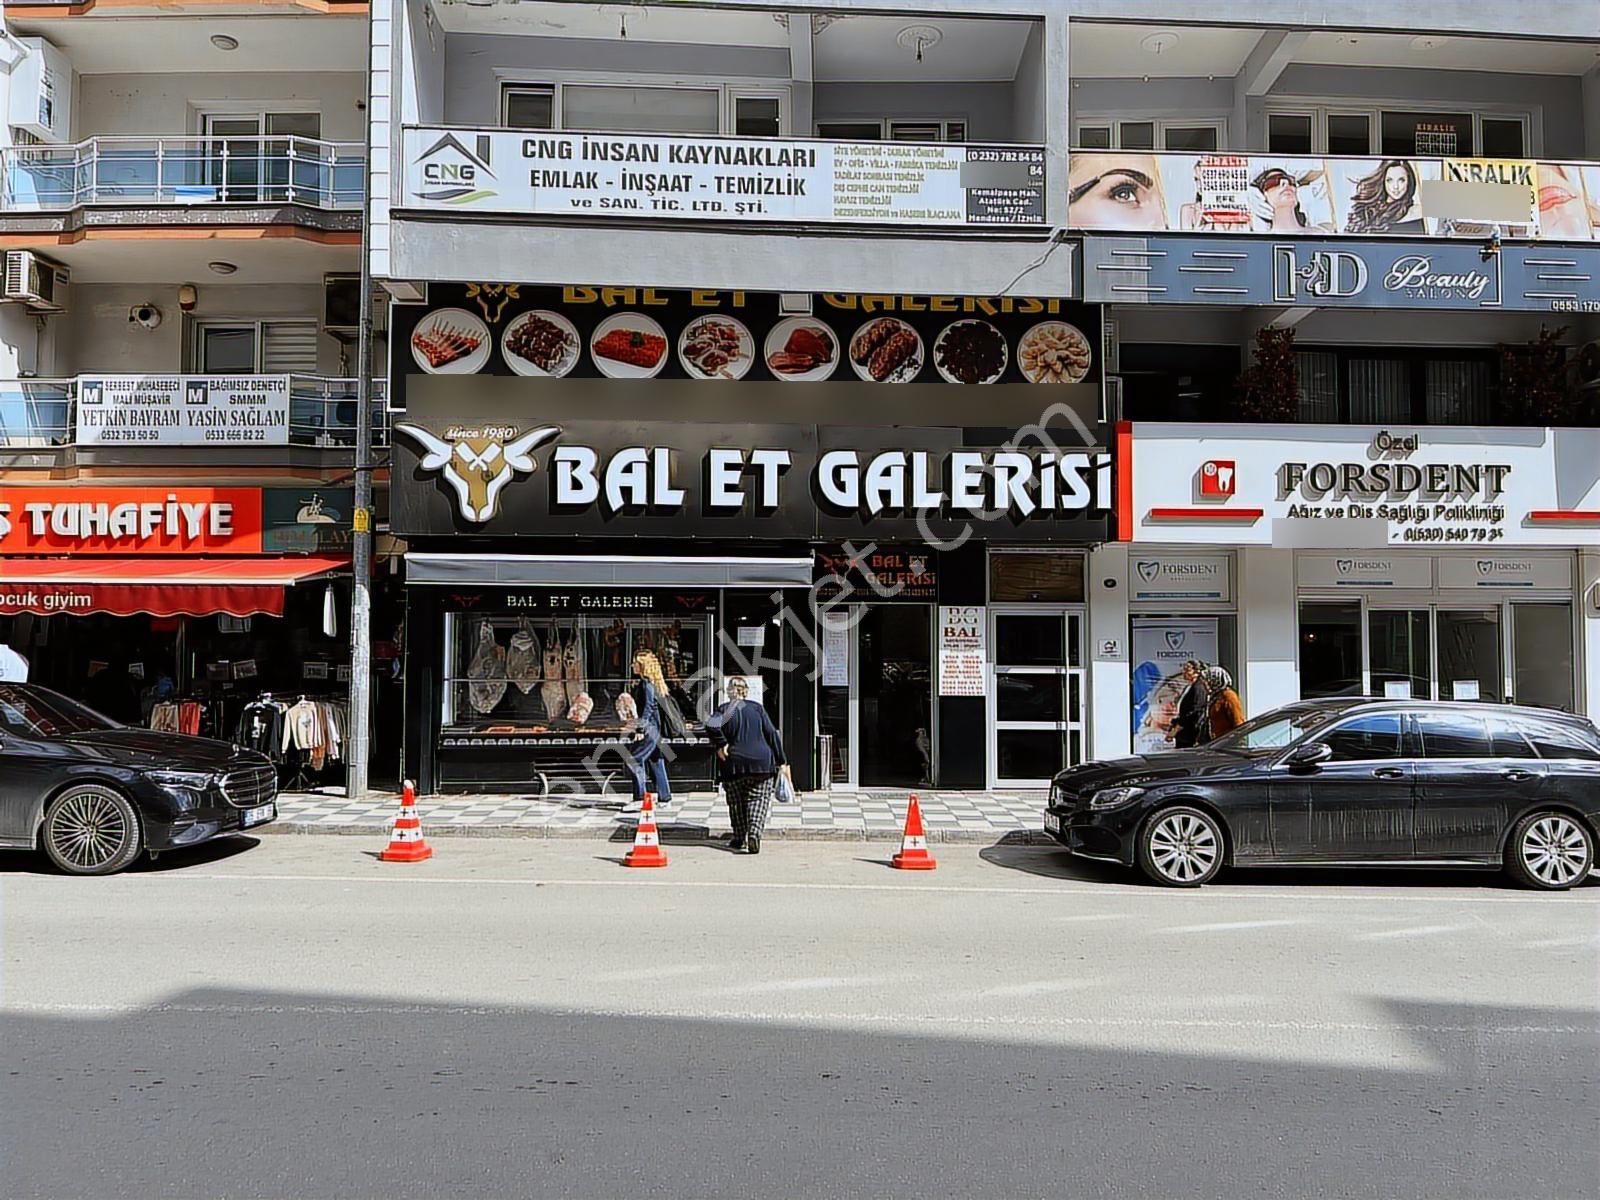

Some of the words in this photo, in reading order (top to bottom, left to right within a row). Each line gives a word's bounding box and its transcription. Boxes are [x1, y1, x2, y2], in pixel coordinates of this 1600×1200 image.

[522, 139, 572, 159] CNG
[582, 136, 659, 162] İNSAN
[669, 144, 816, 168] KAYNAKLARI
[424, 163, 475, 180] CNG
[530, 169, 599, 190] EMLAK
[621, 167, 693, 197] İNŞAAT
[714, 172, 806, 197] TEMİZLİK
[570, 199, 592, 208] ve
[600, 197, 643, 209] SAN.
[651, 196, 684, 211] TİC.
[692, 200, 728, 212] LTD.
[735, 199, 768, 216] ŞTİ.
[1384, 254, 1490, 299] Beauty
[82, 405, 127, 426] YETKİN
[130, 409, 180, 426] BAYRAM
[187, 405, 227, 426] YASİN
[230, 405, 285, 426] SAĞLAM
[1376, 430, 1419, 451] Özel
[554, 446, 685, 512] BAL
[710, 449, 791, 507] ET
[1284, 462, 1511, 494] FORSDENT
[25, 493, 234, 540] TUHAFİYE
[1325, 507, 1344, 519] ve
[1162, 564, 1217, 574] FORSDENT
[44, 591, 91, 610] giyim
[507, 595, 537, 607] BAL
[550, 596, 570, 607] ET
[944, 626, 983, 638] BAL
